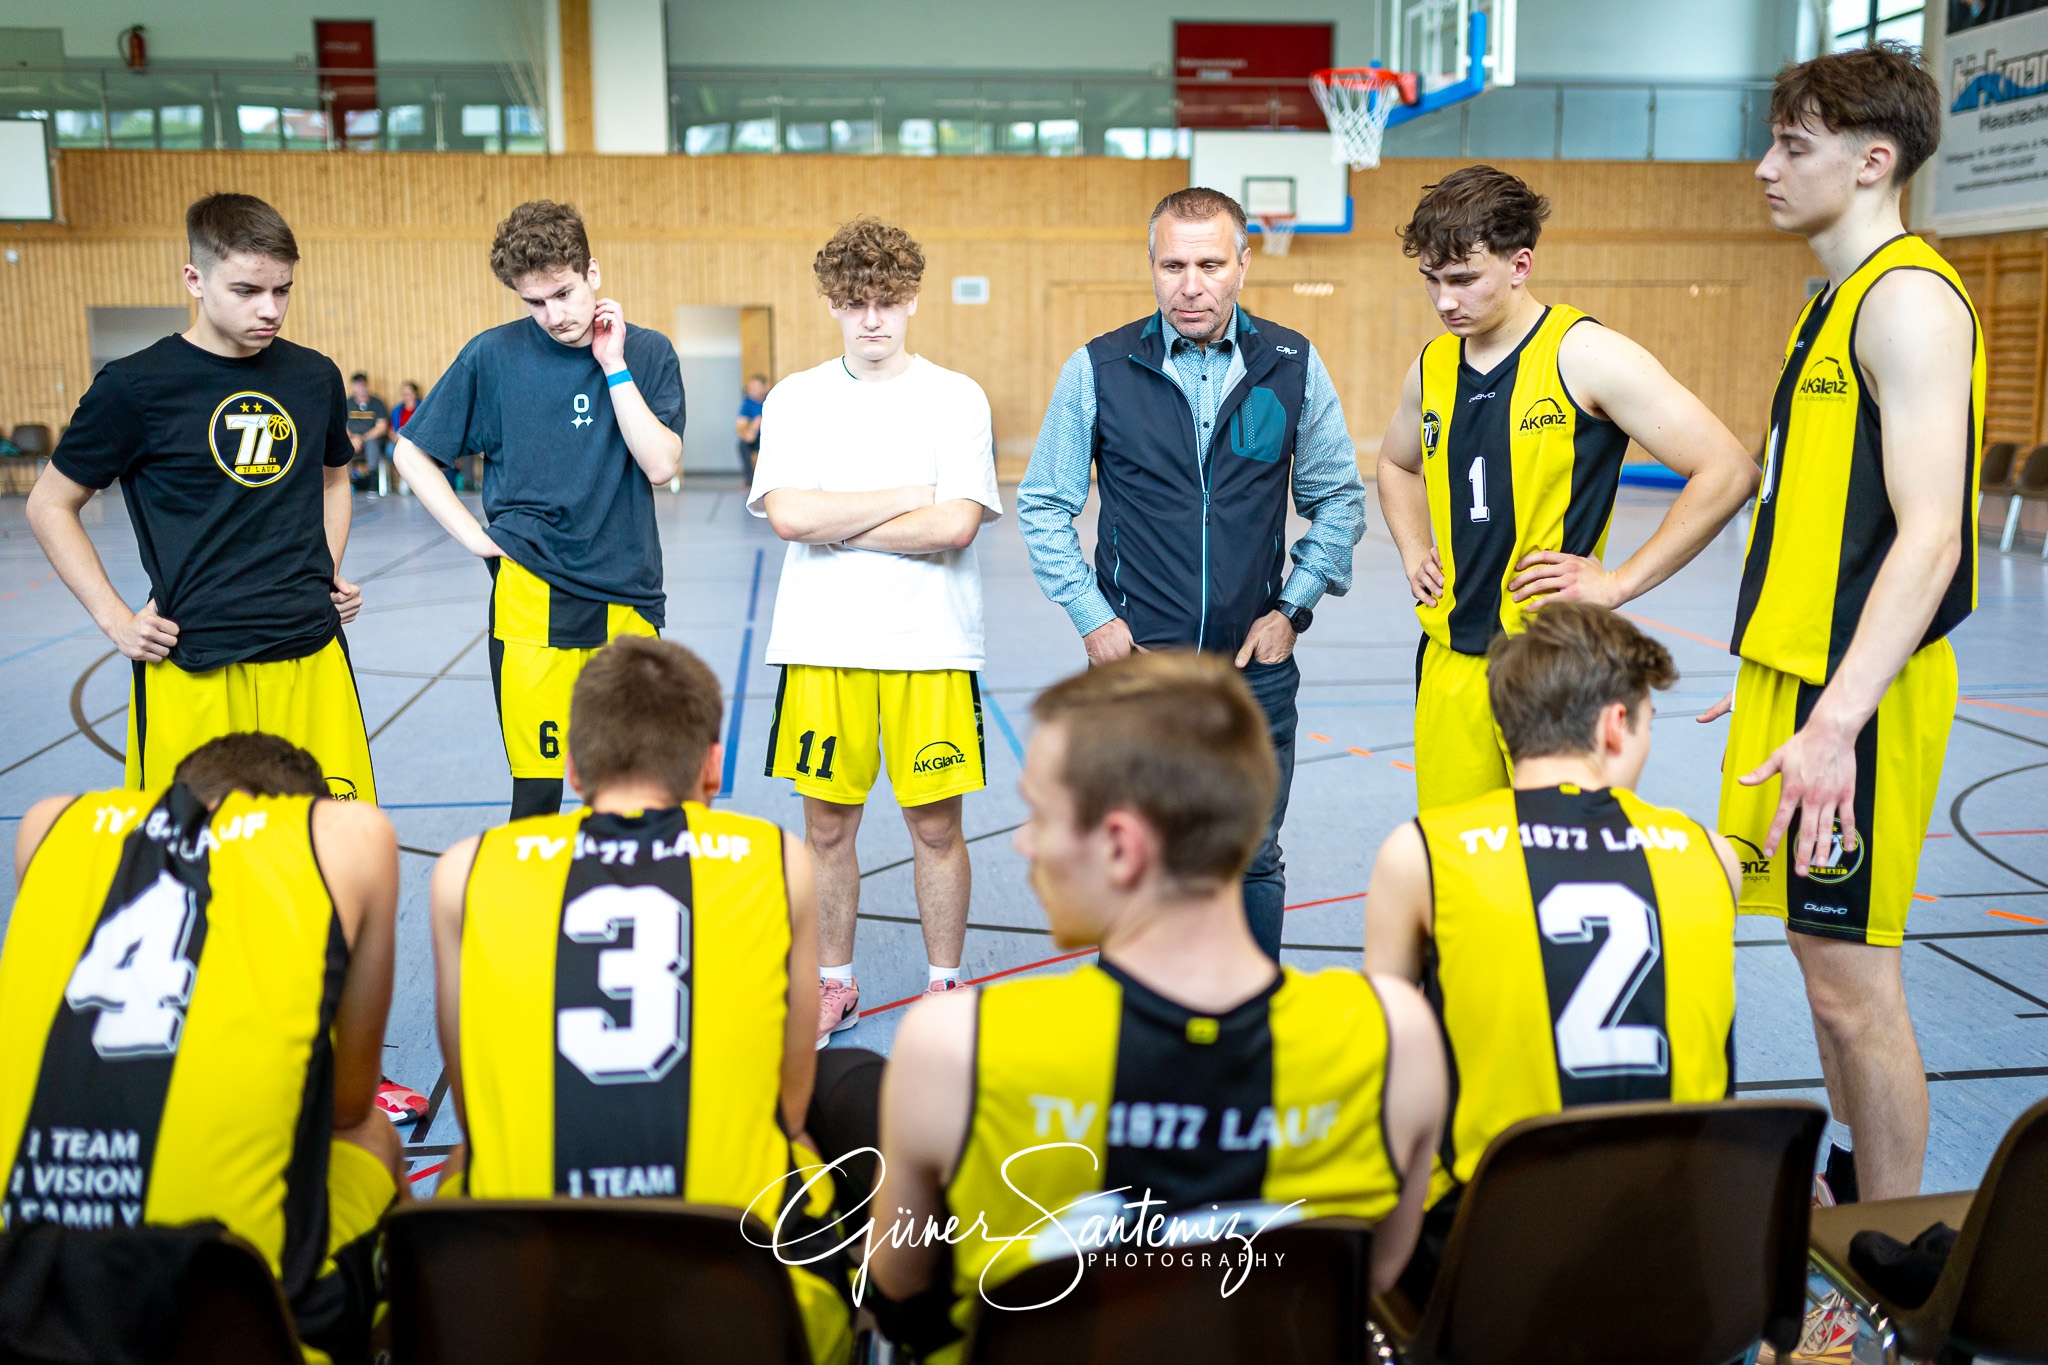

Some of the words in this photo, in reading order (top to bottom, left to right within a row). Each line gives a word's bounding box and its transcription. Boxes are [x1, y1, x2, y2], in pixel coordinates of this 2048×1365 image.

[1468, 456, 1490, 522] 1
[539, 720, 561, 760] 6
[796, 730, 837, 782] 11
[514, 835, 567, 861] TV
[652, 829, 750, 862] LAUF
[1459, 825, 1508, 854] TV
[1518, 822, 1588, 850] 1877
[1601, 826, 1689, 852] LAUF
[64, 869, 198, 1061] 4
[557, 883, 691, 1085] 3
[1537, 880, 1668, 1079] 2
[50, 1126, 140, 1160] TEAM
[1028, 1093, 1097, 1142] TV
[1107, 1101, 1207, 1149] 1877
[33, 1163, 143, 1198] VISION
[588, 1164, 676, 1198] TEAM
